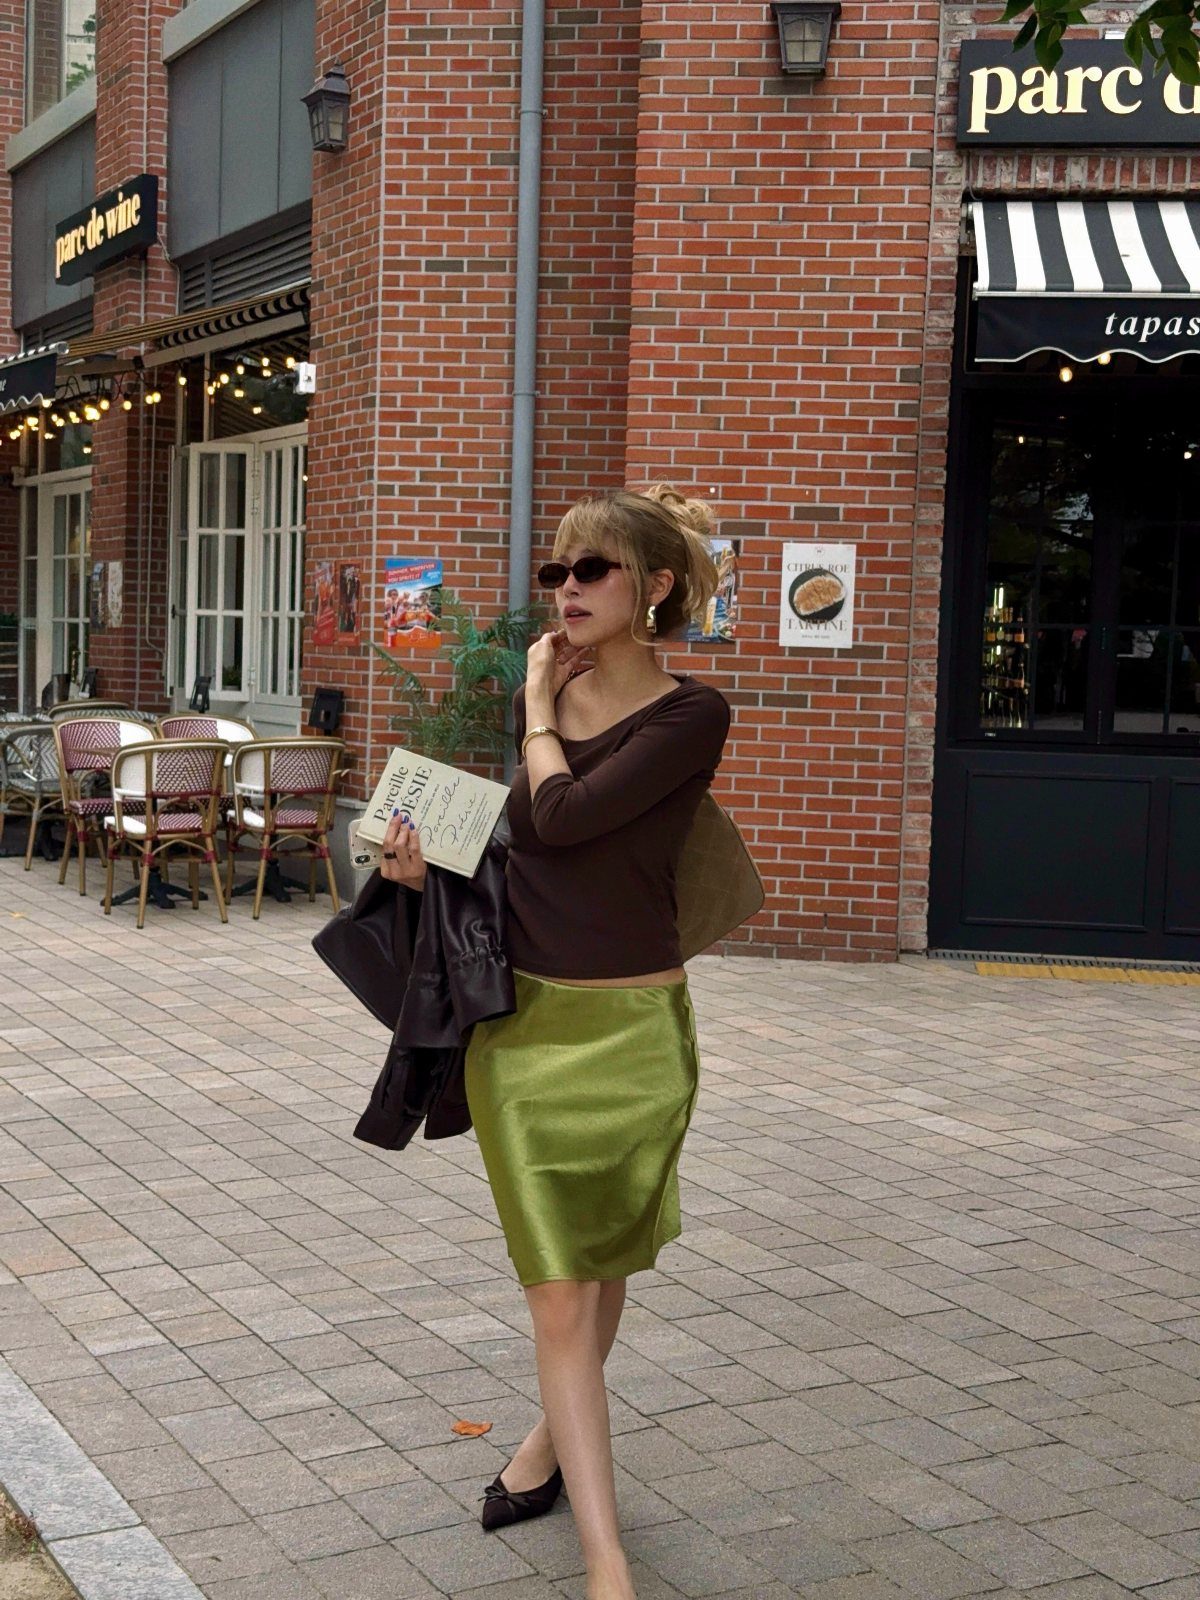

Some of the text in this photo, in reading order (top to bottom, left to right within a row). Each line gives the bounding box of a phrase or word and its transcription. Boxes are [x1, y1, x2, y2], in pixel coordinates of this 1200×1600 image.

[966, 65, 1143, 134] parc
[55, 191, 141, 279] parc de wine
[1104, 312, 1200, 343] tapas
[787, 562, 850, 574] CITRUS ROE
[786, 618, 848, 631] TARTINE
[373, 766, 409, 822] Pareille
[400, 766, 433, 818] ÉSIE
